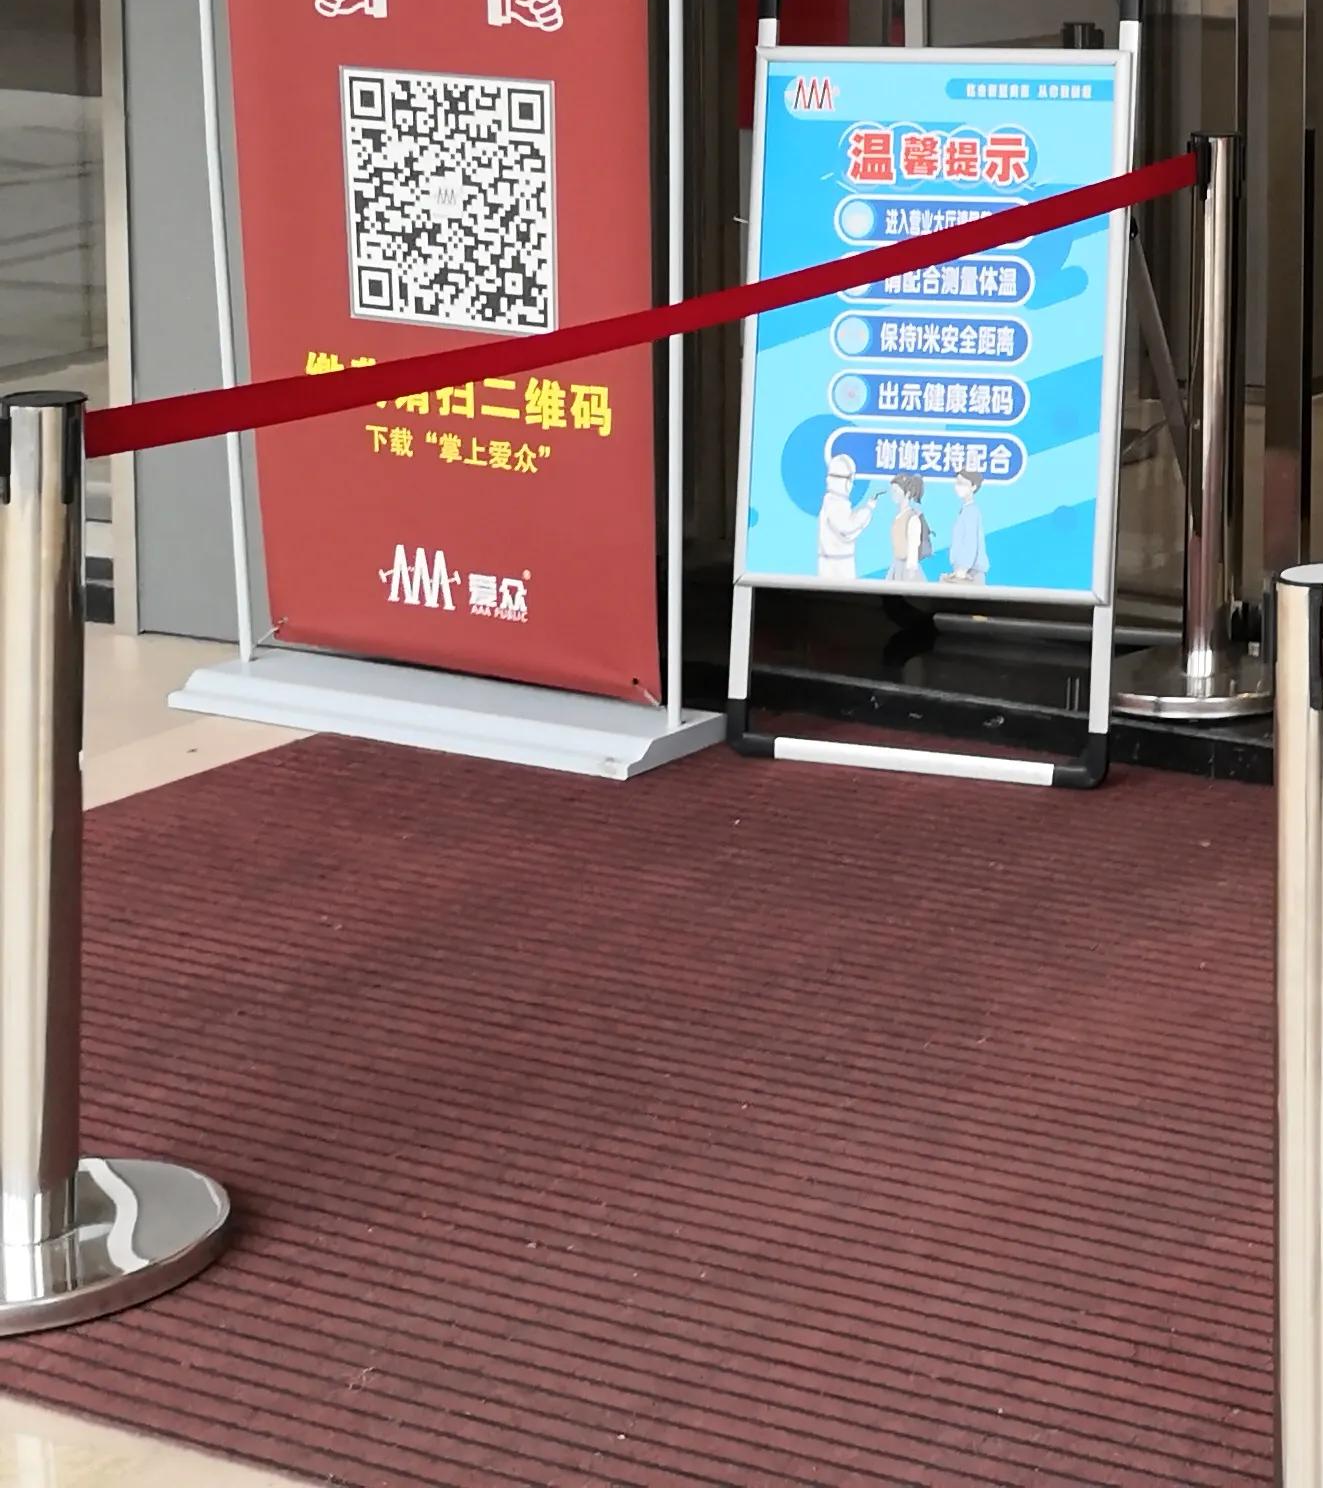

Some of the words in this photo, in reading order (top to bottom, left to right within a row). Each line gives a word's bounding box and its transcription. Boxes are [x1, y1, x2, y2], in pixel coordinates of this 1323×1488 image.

[847, 131, 1028, 183] 温馨提示
[879, 321, 1015, 357] 保持1米安全距离
[878, 380, 1014, 416] 出示健康绿码
[874, 437, 1013, 475] 谢谢支持配合
[468, 572, 528, 612] 爱众
